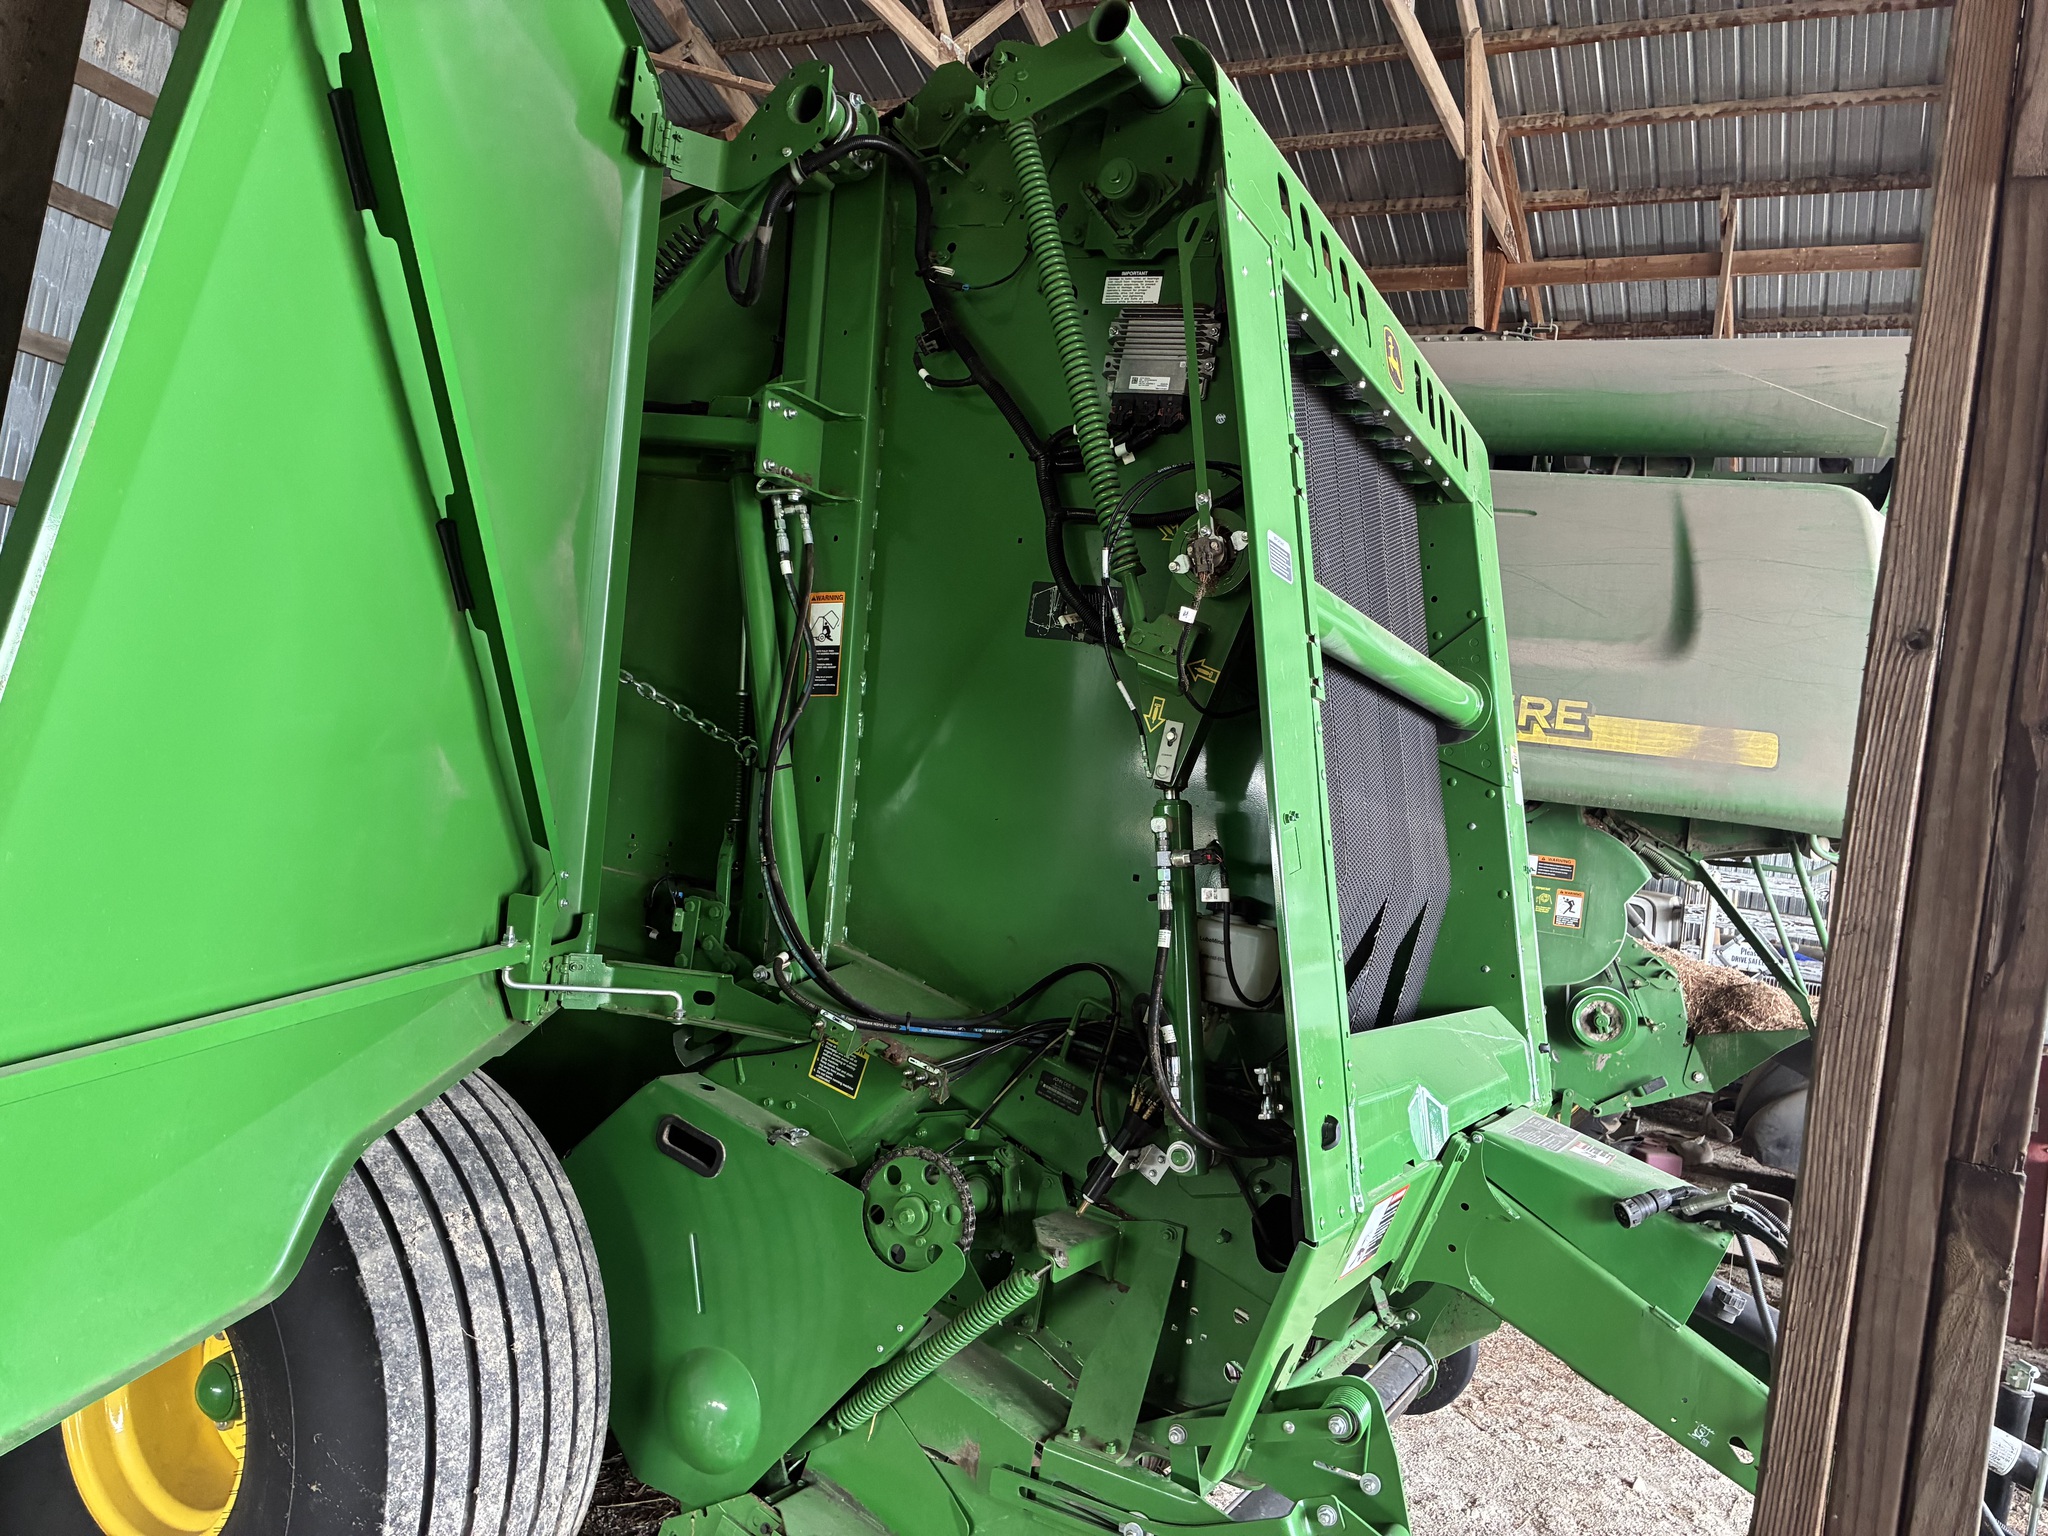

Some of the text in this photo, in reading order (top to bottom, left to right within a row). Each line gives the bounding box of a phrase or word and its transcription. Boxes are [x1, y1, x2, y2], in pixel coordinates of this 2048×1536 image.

[1513, 695, 1590, 733] RE
[1740, 947, 1757, 956] Pleas
[1731, 955, 1747, 963] DRIVE
